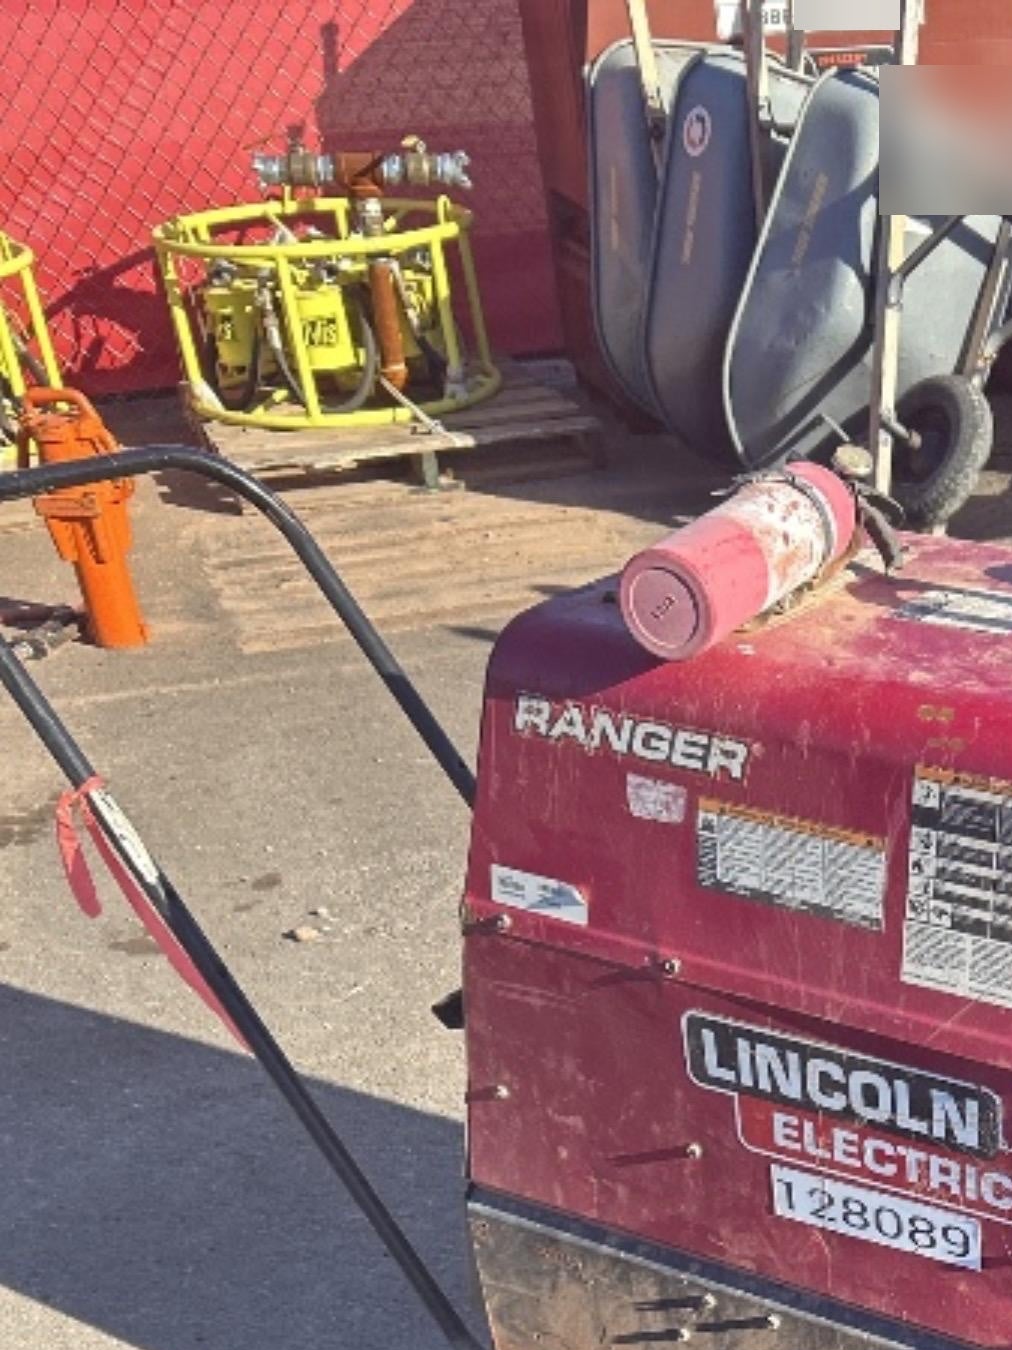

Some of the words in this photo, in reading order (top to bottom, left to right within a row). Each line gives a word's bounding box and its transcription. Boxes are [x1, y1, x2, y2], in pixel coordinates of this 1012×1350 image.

[514, 694, 749, 781] RANGER
[701, 1028, 980, 1150] LINCOLN
[776, 1176, 972, 1259] 128089
